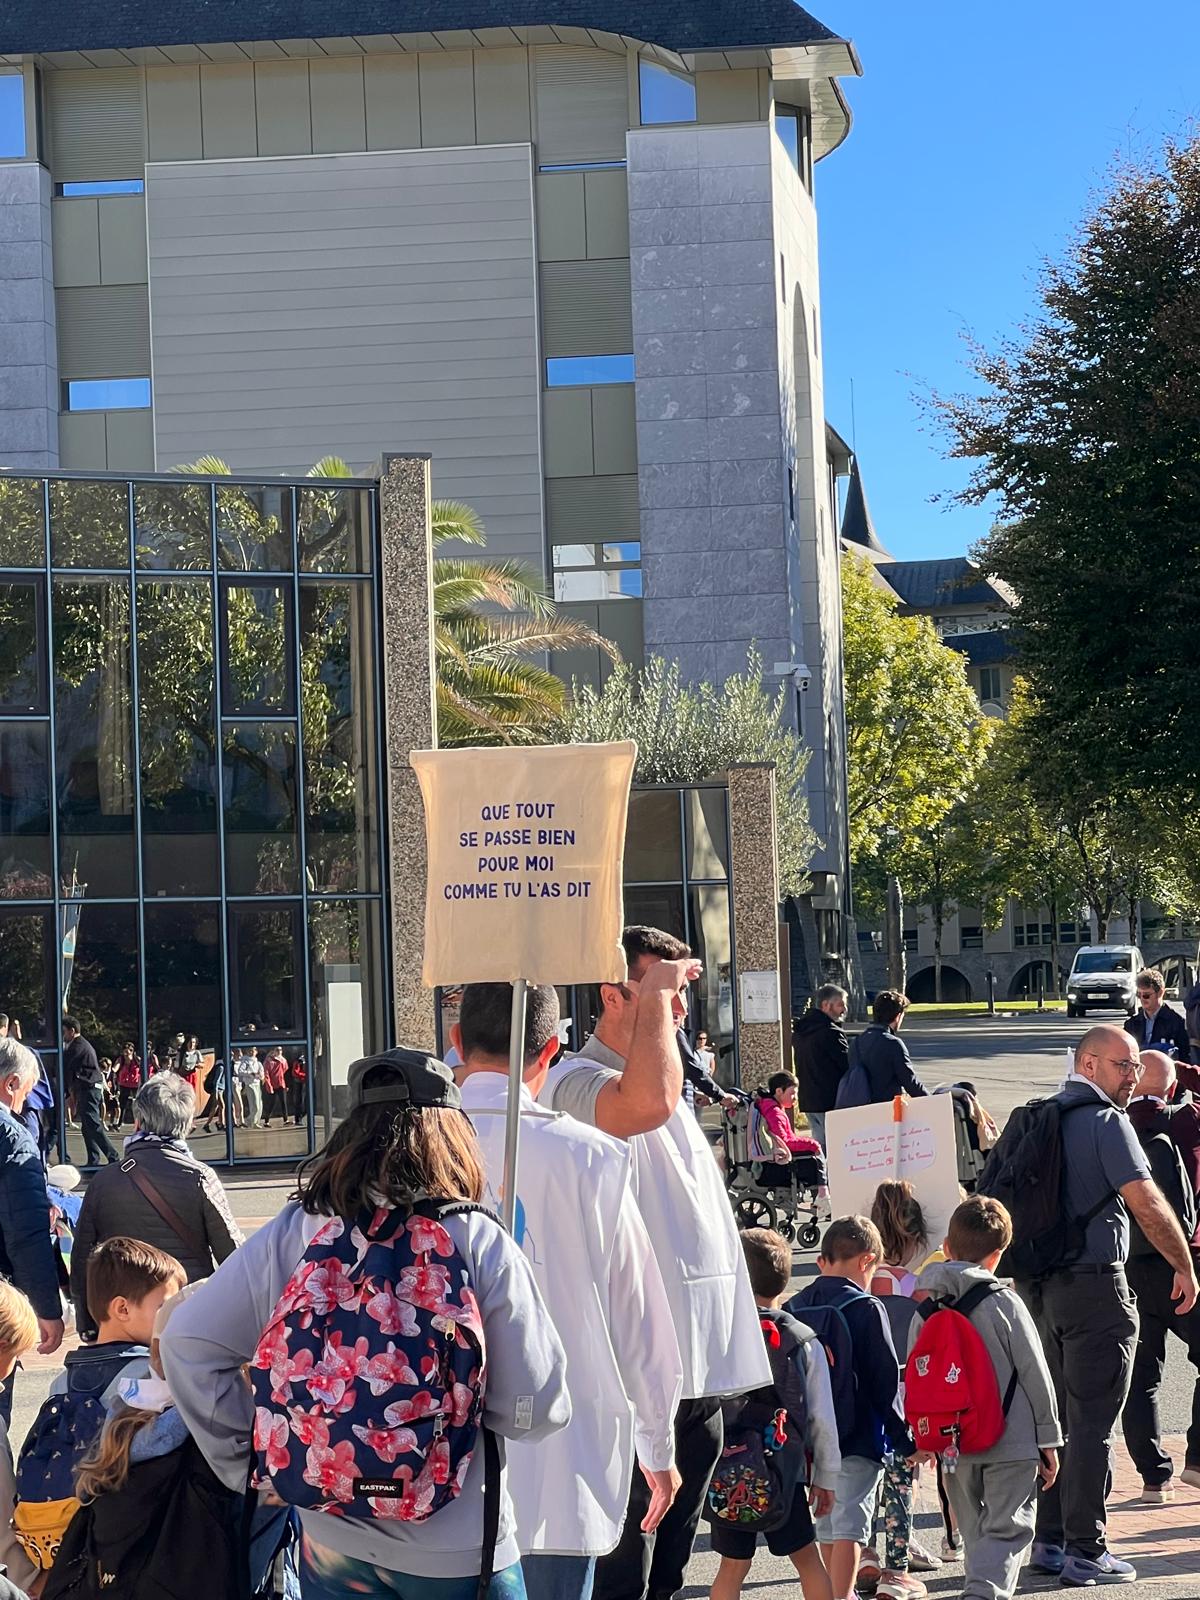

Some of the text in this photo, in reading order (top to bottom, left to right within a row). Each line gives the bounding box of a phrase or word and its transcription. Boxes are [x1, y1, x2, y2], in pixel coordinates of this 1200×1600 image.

[481, 803, 555, 820] QUE TOUT
[459, 829, 575, 847] SE PASSE BIEN
[478, 855, 554, 872] POUR MOI
[444, 881, 591, 900] COMME TU L'AS DIT
